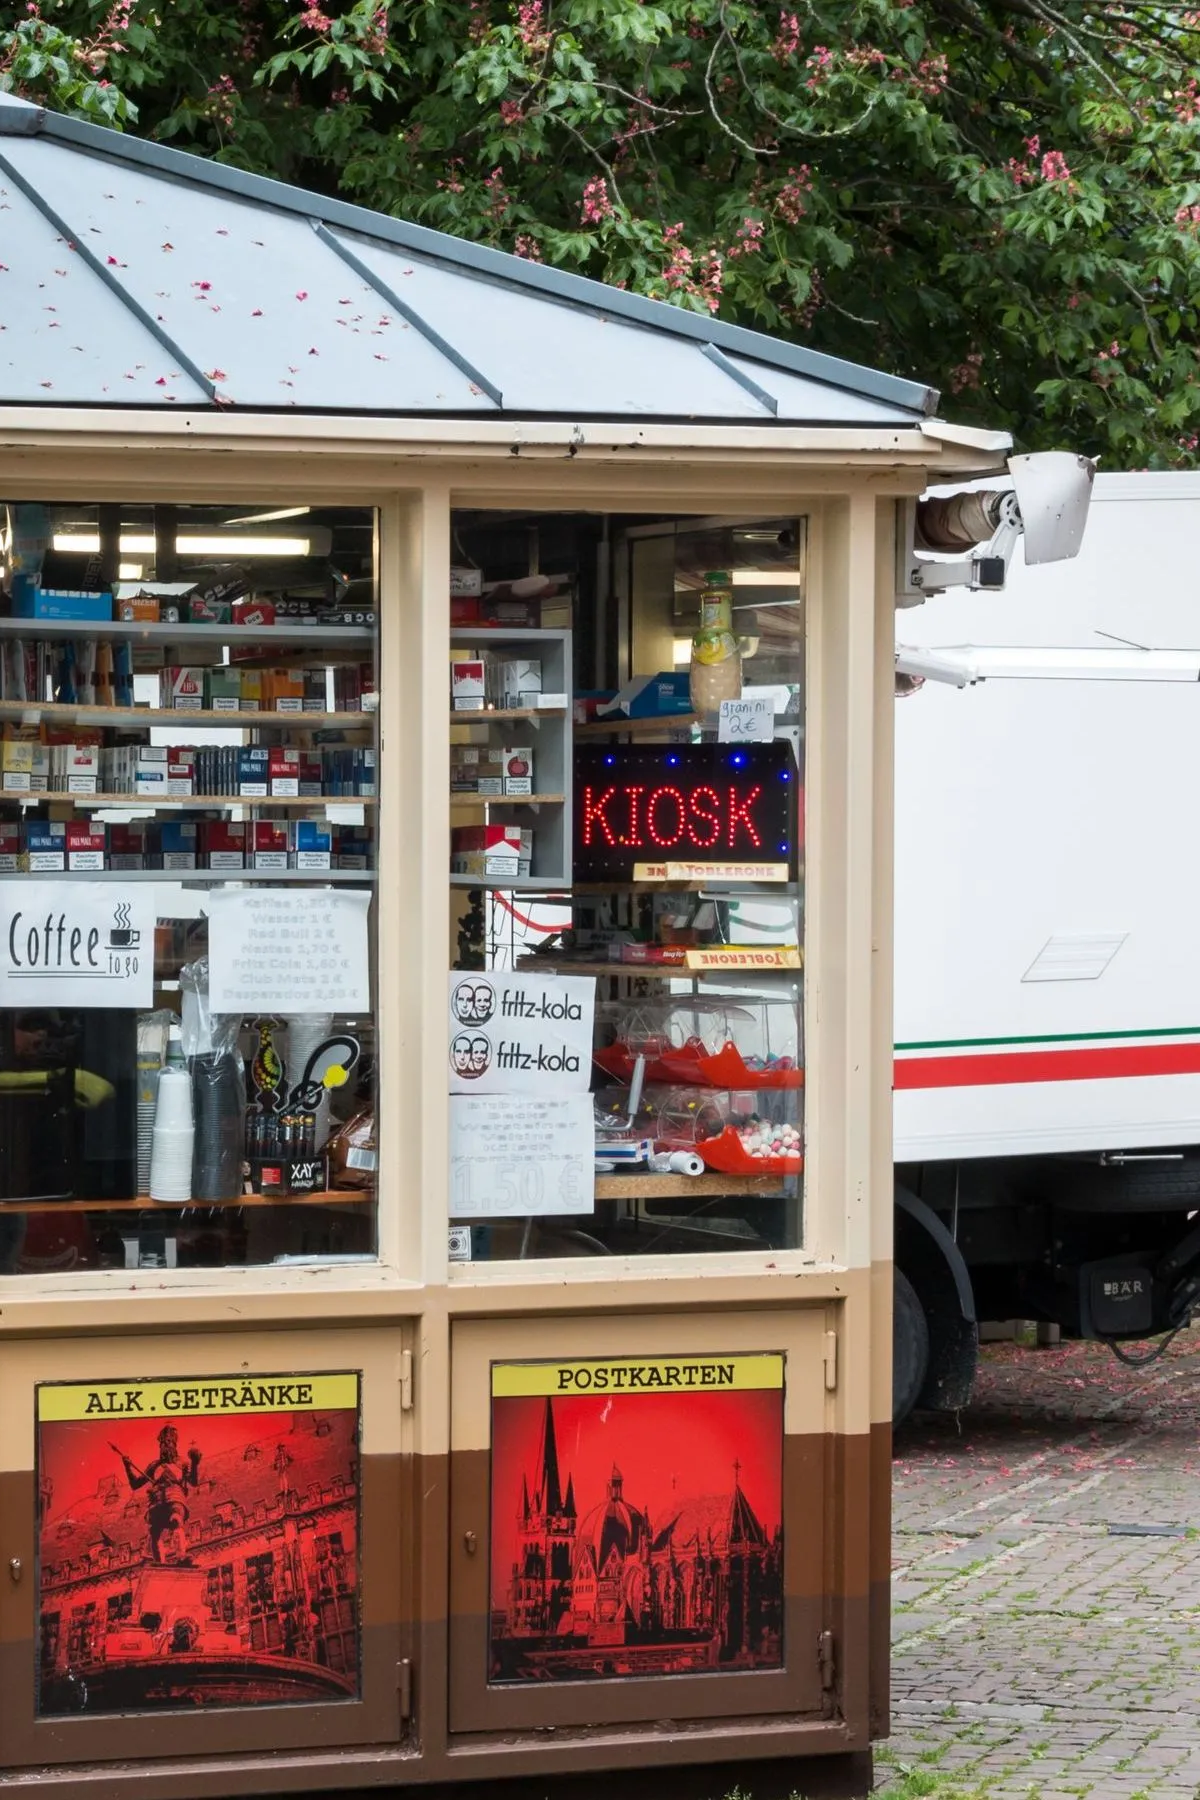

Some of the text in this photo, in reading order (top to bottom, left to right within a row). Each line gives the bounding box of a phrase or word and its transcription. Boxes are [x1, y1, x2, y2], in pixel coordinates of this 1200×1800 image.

[584, 786, 762, 847] KIOSK
[686, 864, 775, 876] TOBLERONE
[9, 911, 99, 967] Coffee
[108, 953, 139, 978] to go
[701, 952, 784, 965] TOBLERONE
[501, 988, 582, 1021] fritz-kola
[497, 1040, 580, 1072] fritz-kola
[454, 1160, 584, 1211] 1.50 €
[557, 1364, 735, 1390] POSTKARTEN
